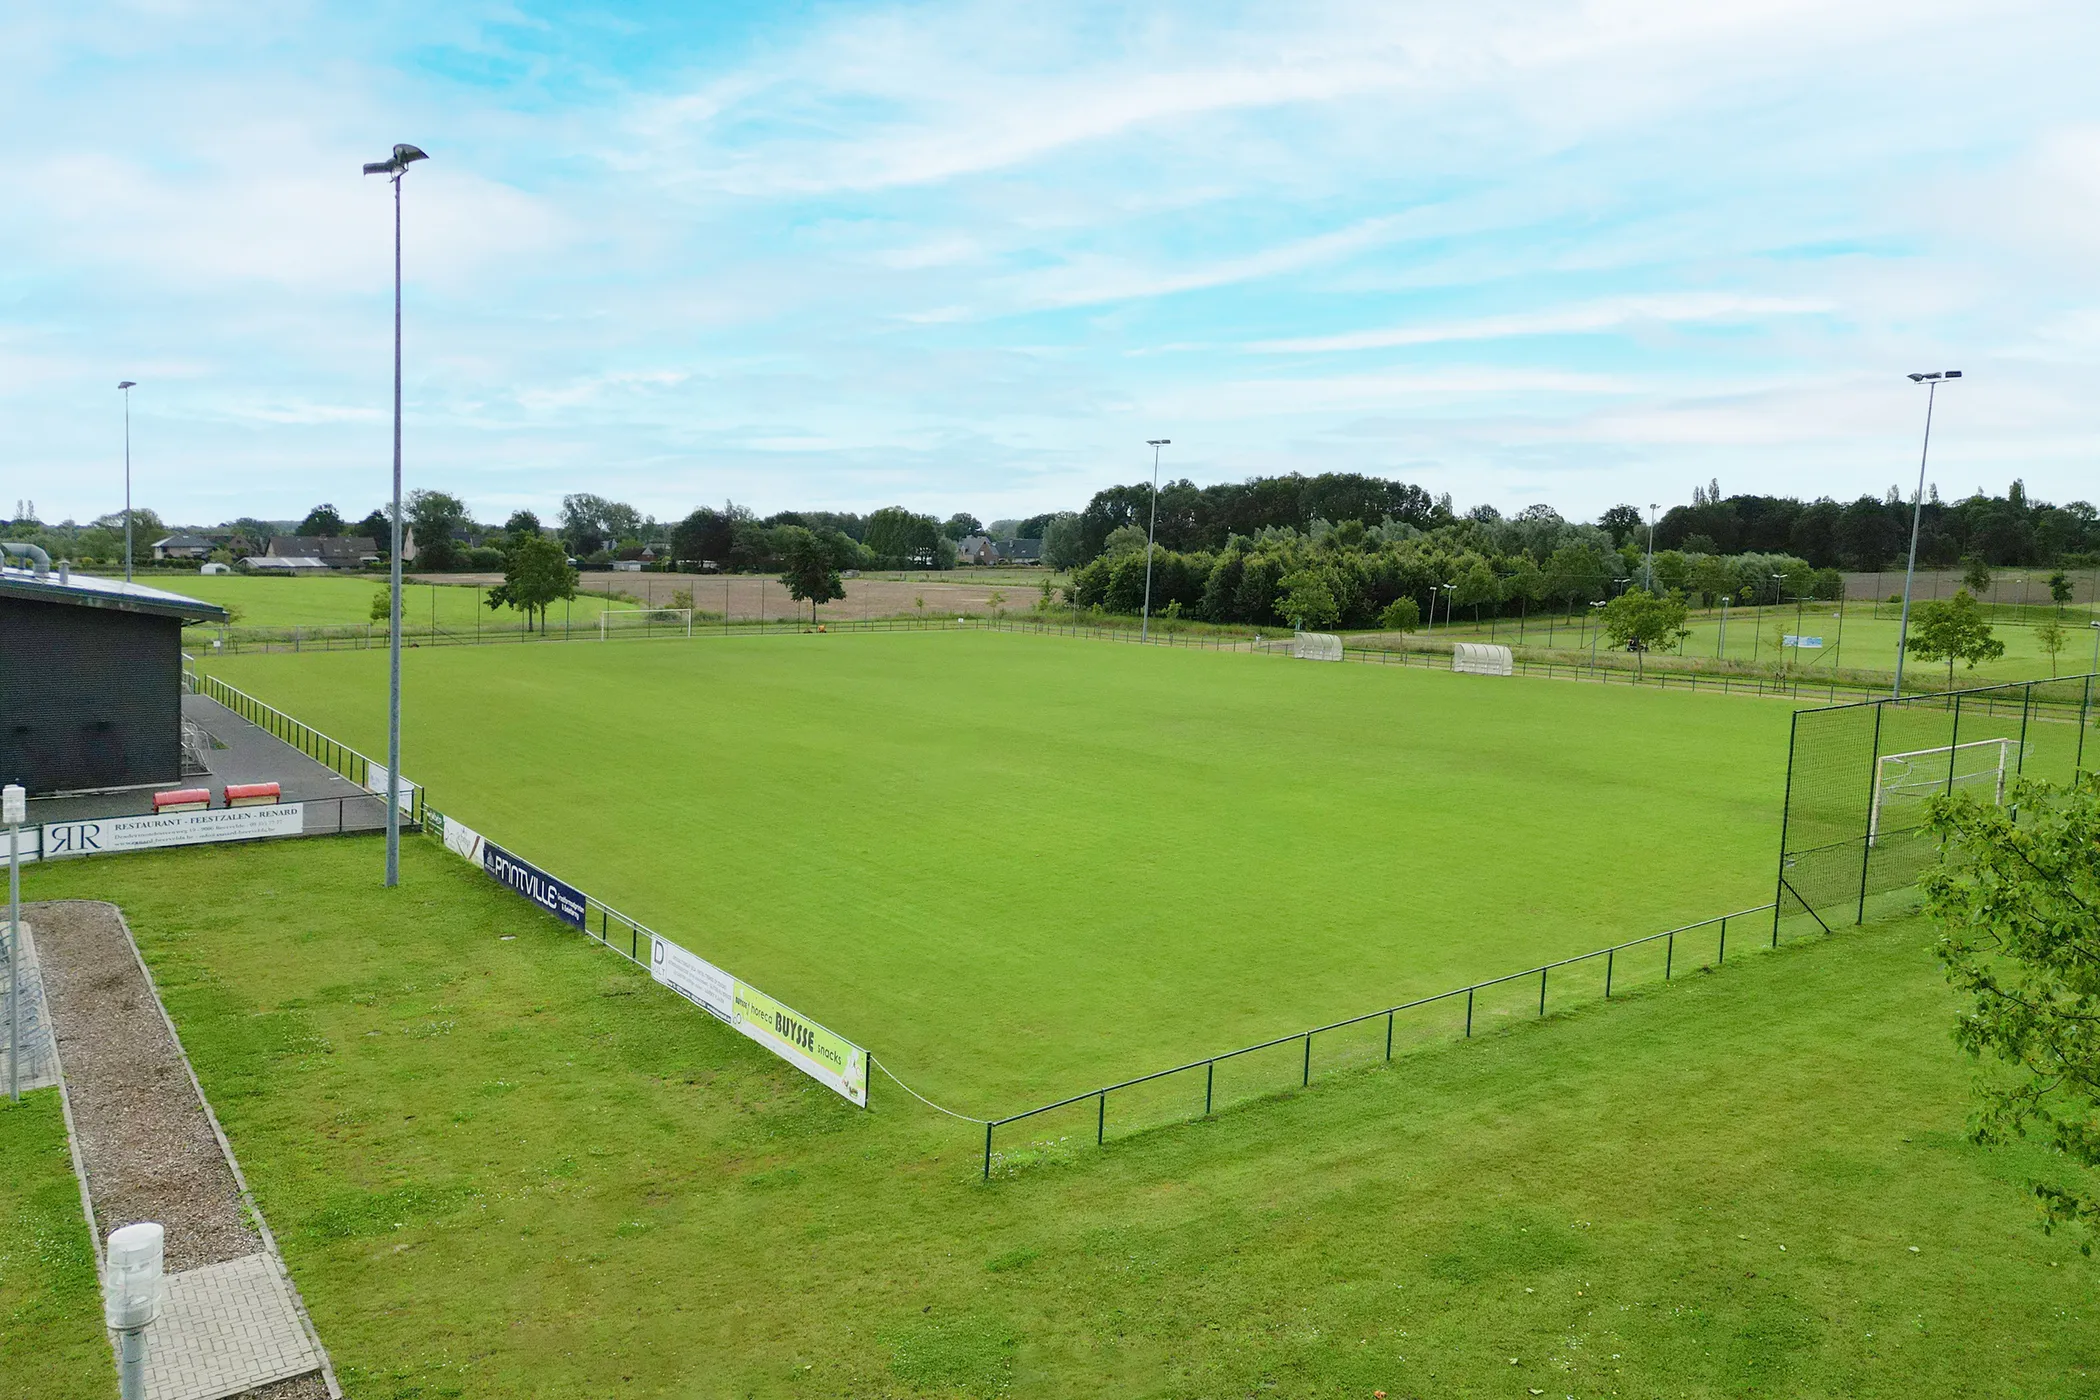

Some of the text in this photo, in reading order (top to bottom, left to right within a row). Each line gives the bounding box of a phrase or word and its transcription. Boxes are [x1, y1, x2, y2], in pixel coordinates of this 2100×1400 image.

[114, 818, 182, 832] RESTAURANT
[190, 814, 251, 826] FEESTZALEN
[259, 808, 298, 819] RENARD
[654, 940, 664, 965] D
[751, 1001, 773, 1025] horeca
[775, 1011, 815, 1053] BUYSSE
[817, 1044, 842, 1066] snacks
